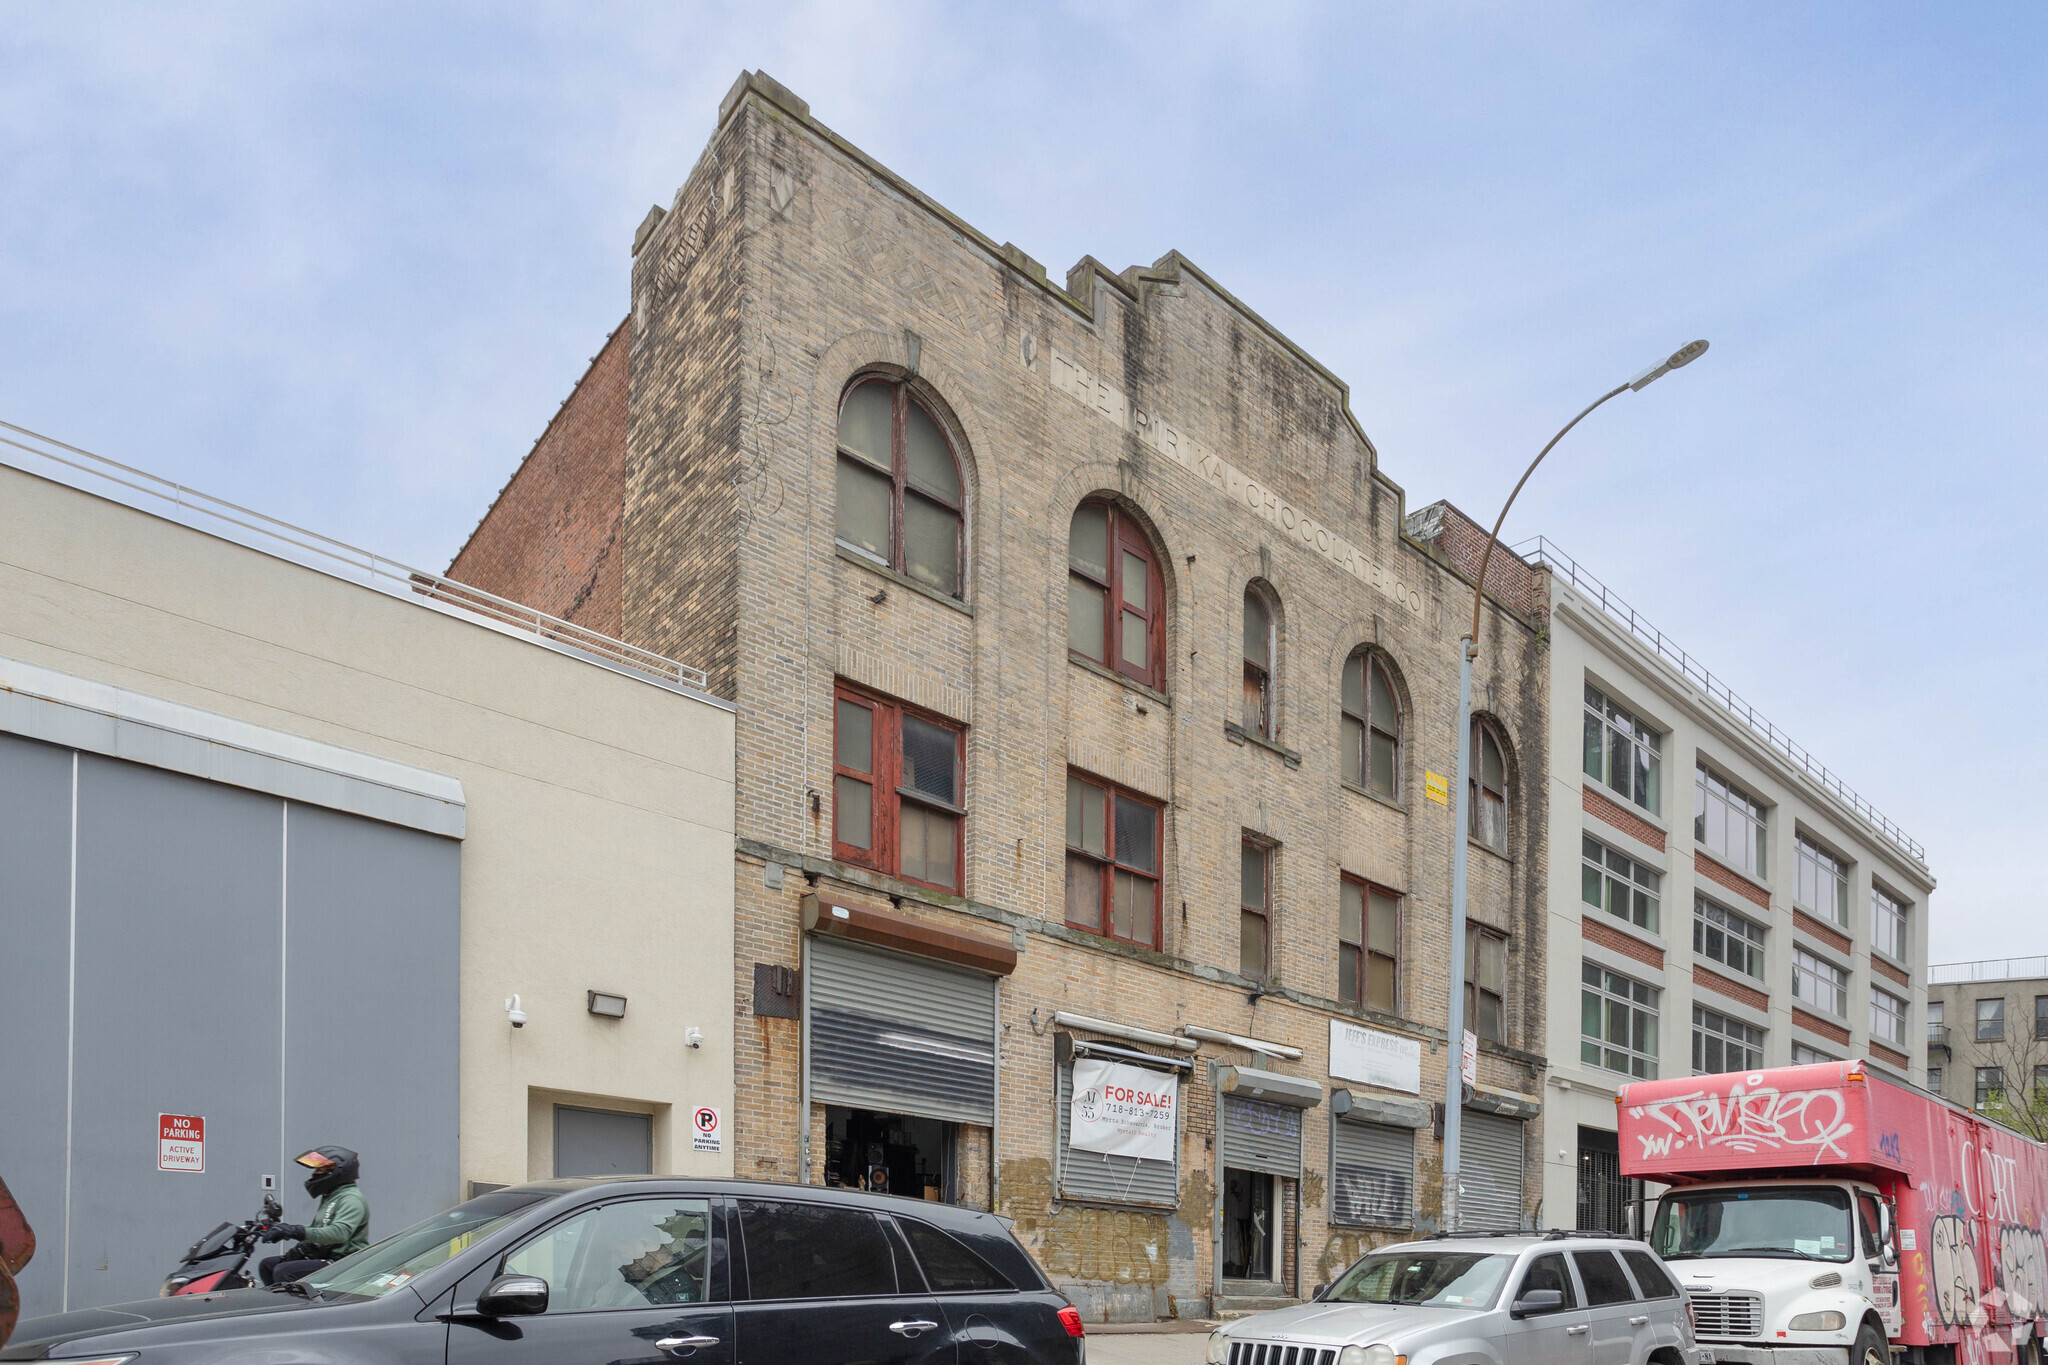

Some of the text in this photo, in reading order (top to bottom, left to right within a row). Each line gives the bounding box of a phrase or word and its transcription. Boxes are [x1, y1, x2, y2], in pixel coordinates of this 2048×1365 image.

[1055, 355, 1422, 612] THE PIRIKA CHOCOLATE CO
[1344, 1028, 1366, 1045] JEFF'S
[1367, 1034, 1399, 1053] EXPRESS
[1105, 1085, 1171, 1108] FOR SALE!
[1106, 1103, 1170, 1120] 718-813-7259
[173, 1118, 191, 1128] NO
[163, 1127, 200, 1139] PARKING
[169, 1146, 195, 1154] ACTIVE
[163, 1155, 200, 1163] DRIVEWAY
[1961, 1140, 2020, 1225] CORT
